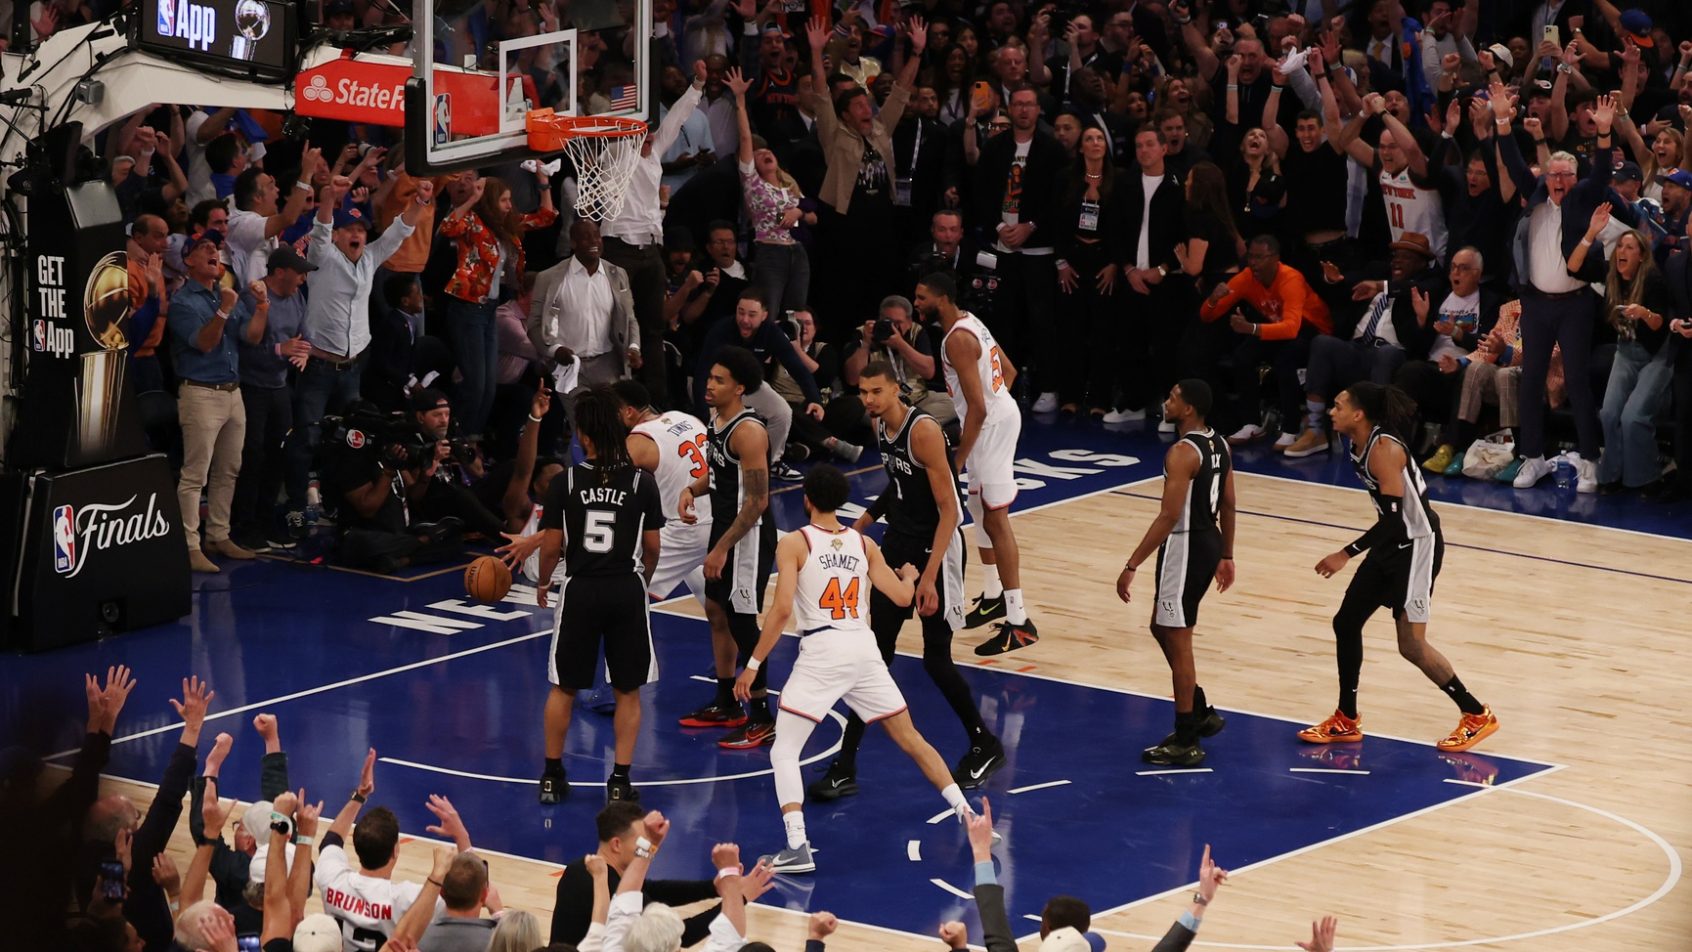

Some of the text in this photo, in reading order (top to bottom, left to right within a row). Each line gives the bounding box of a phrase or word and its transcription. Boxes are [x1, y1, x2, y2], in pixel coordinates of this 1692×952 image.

[175, 0, 216, 51] App
[1390, 202, 1405, 229] 11
[37, 254, 65, 286] GET
[38, 287, 67, 318] THE
[46, 321, 74, 359] App
[580, 487, 627, 506] CASTLE
[65, 492, 170, 579] Finals
[583, 509, 617, 554] 5
[818, 553, 860, 572] SHAMET
[818, 576, 861, 620] 44
[326, 887, 392, 921] BRUNSON
